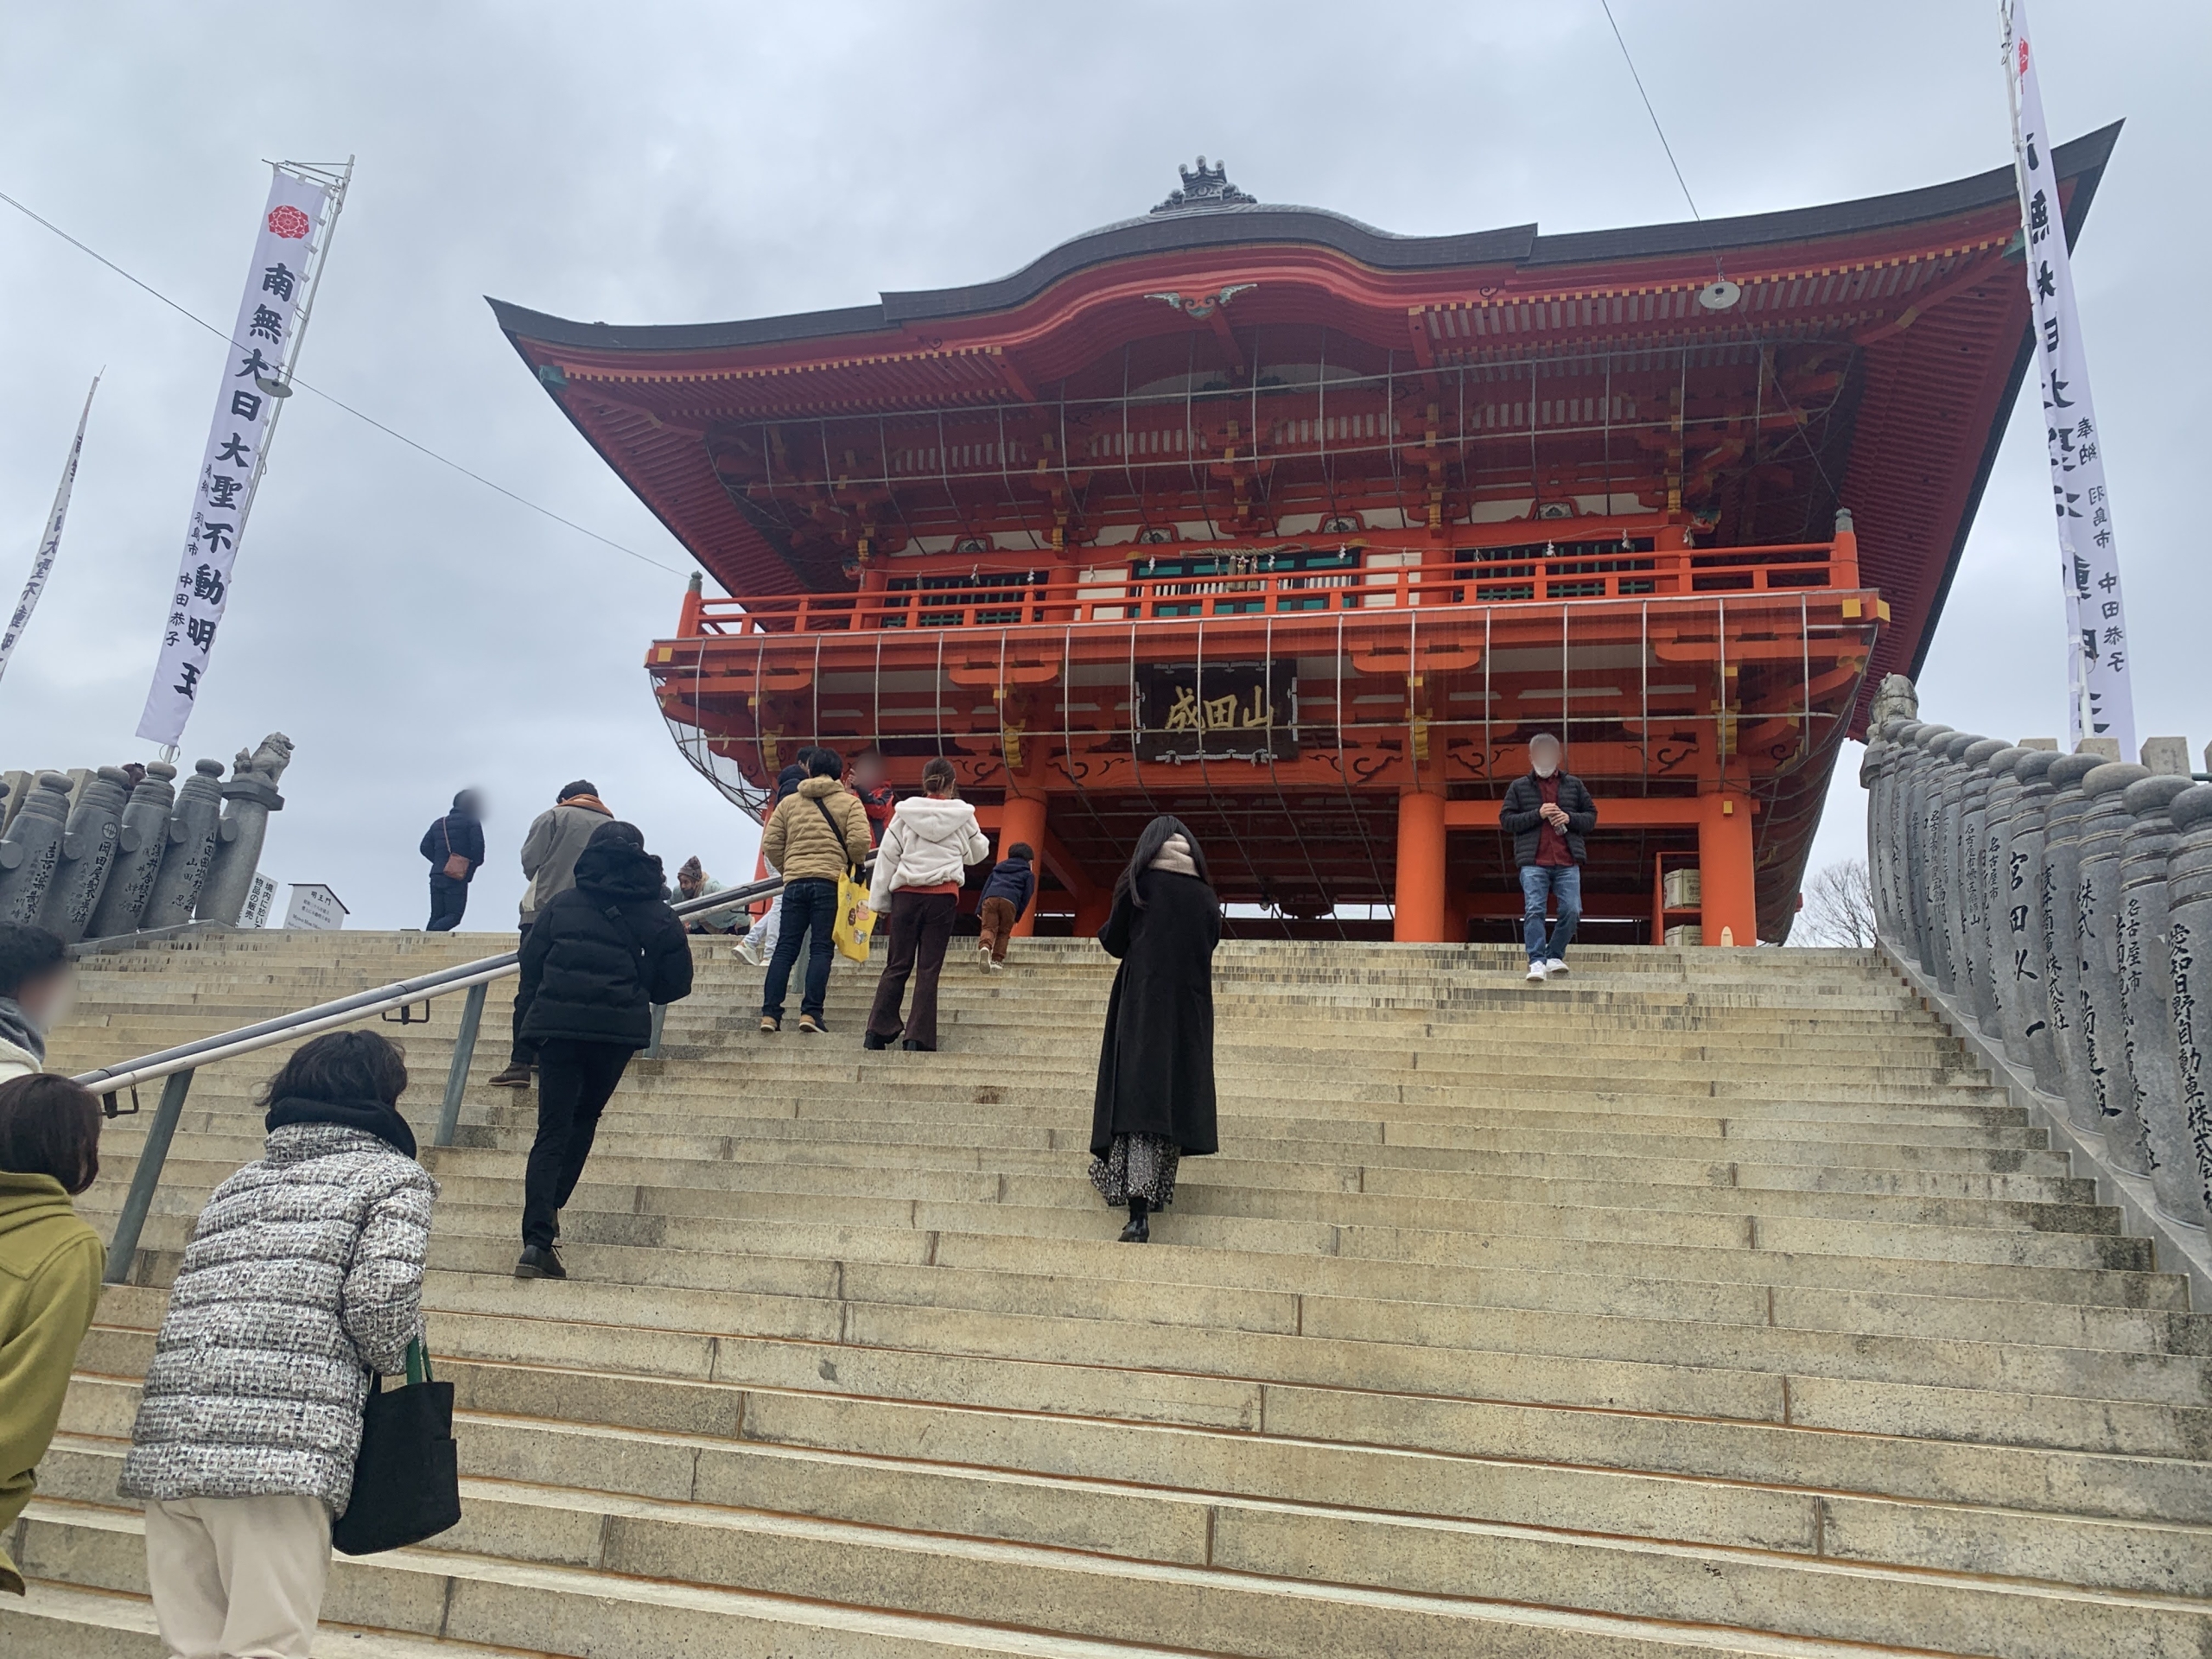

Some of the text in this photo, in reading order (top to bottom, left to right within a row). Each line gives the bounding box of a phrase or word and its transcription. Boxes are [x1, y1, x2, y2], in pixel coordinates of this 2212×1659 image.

[174, 263, 296, 701] 南無大日大聖不動明王
[188, 512, 205, 556] 羽島市
[166, 572, 194, 647] 中田恭子
[1165, 684, 1274, 734] 成田山
[245, 877, 264, 920] 物品の販売
[310, 891, 332, 906] 明王門
[1988, 836, 2000, 903] 名古屋市
[2126, 898, 2141, 993] 名古屋市
